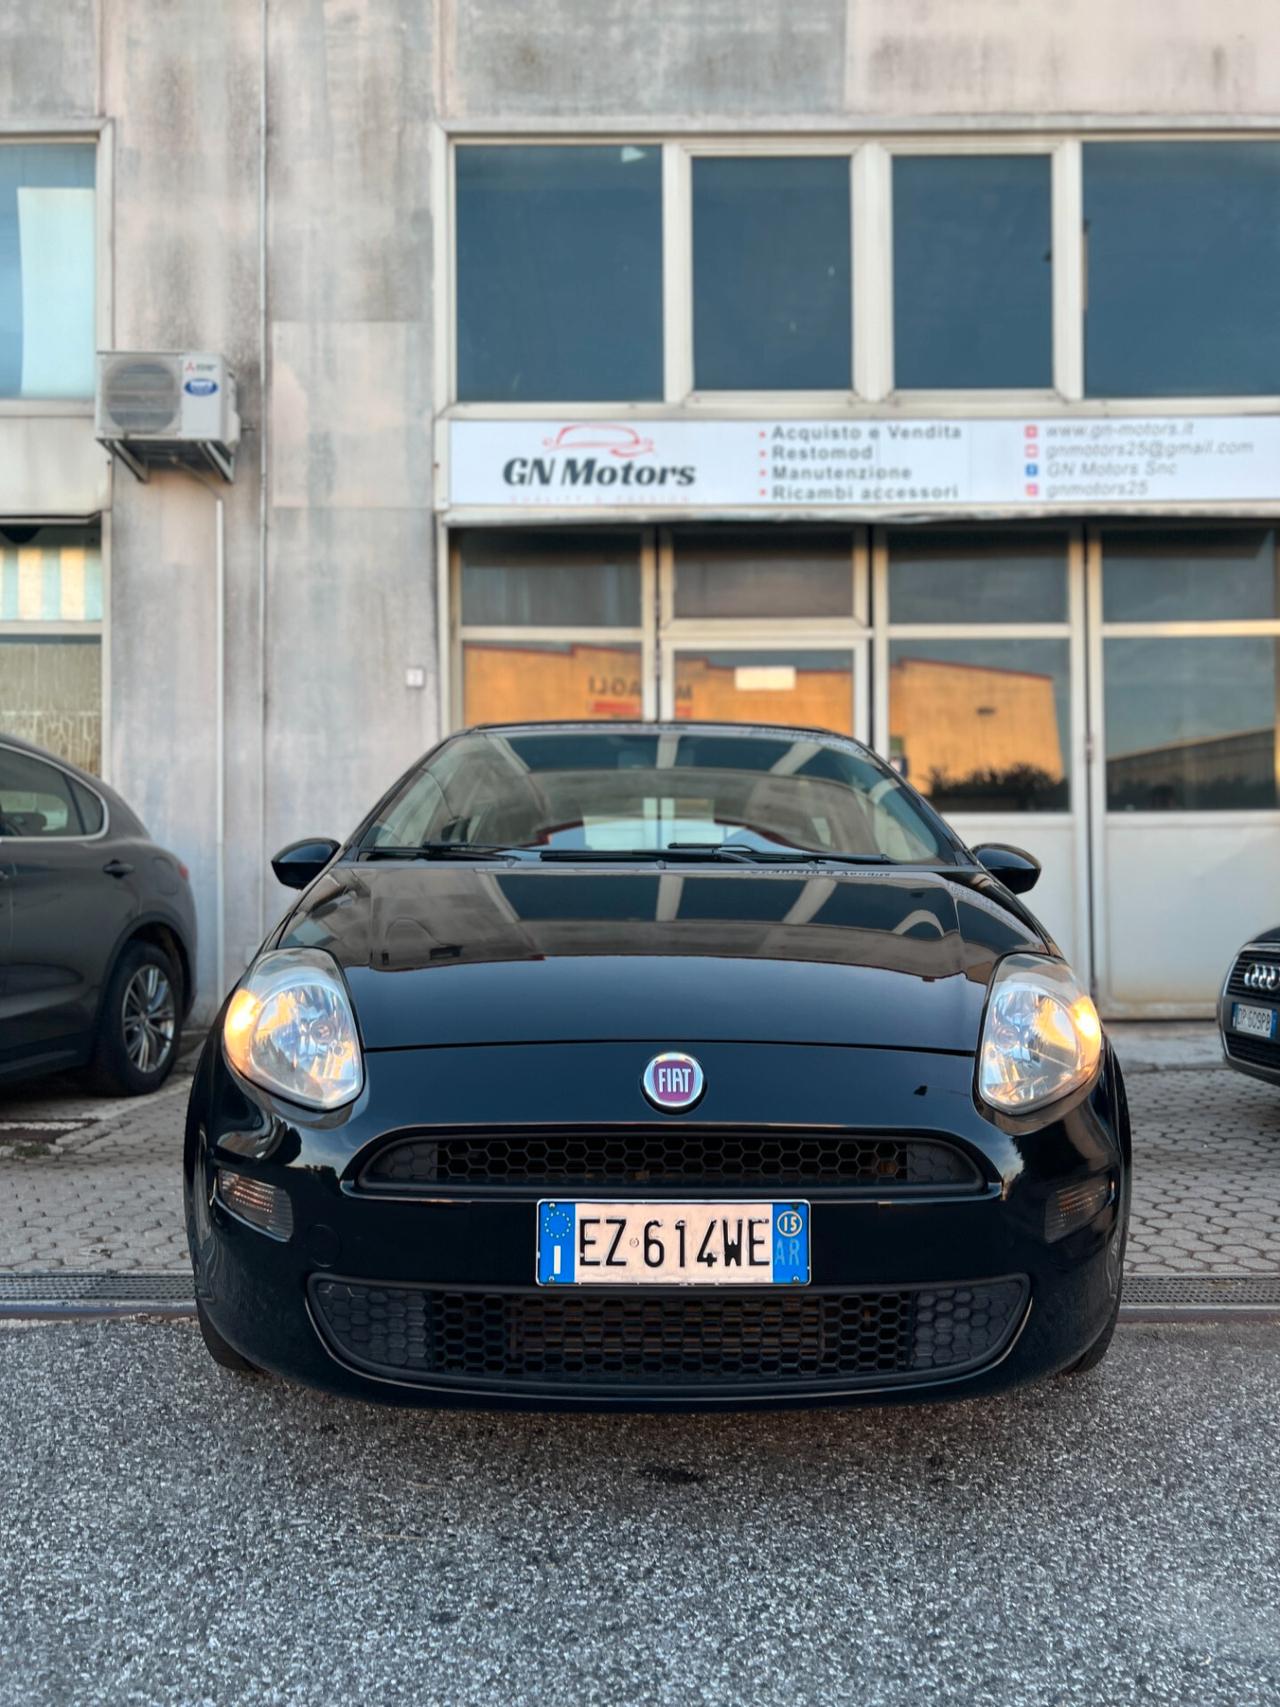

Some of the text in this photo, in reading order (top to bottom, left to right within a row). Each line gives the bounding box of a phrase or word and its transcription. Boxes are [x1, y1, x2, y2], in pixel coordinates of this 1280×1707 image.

[772, 424, 962, 442] Acquisto e Vendita
[772, 445, 873, 460] Restomod
[503, 457, 696, 486] GN Motors
[772, 466, 912, 481] Manutenzione
[1047, 462, 1074, 478] GN
[1080, 461, 1139, 477] Motors
[772, 485, 959, 500] Ricambi accessori
[658, 1068, 691, 1093] FIAT
[783, 1216, 798, 1232] 15
[774, 1239, 800, 1266] AR
